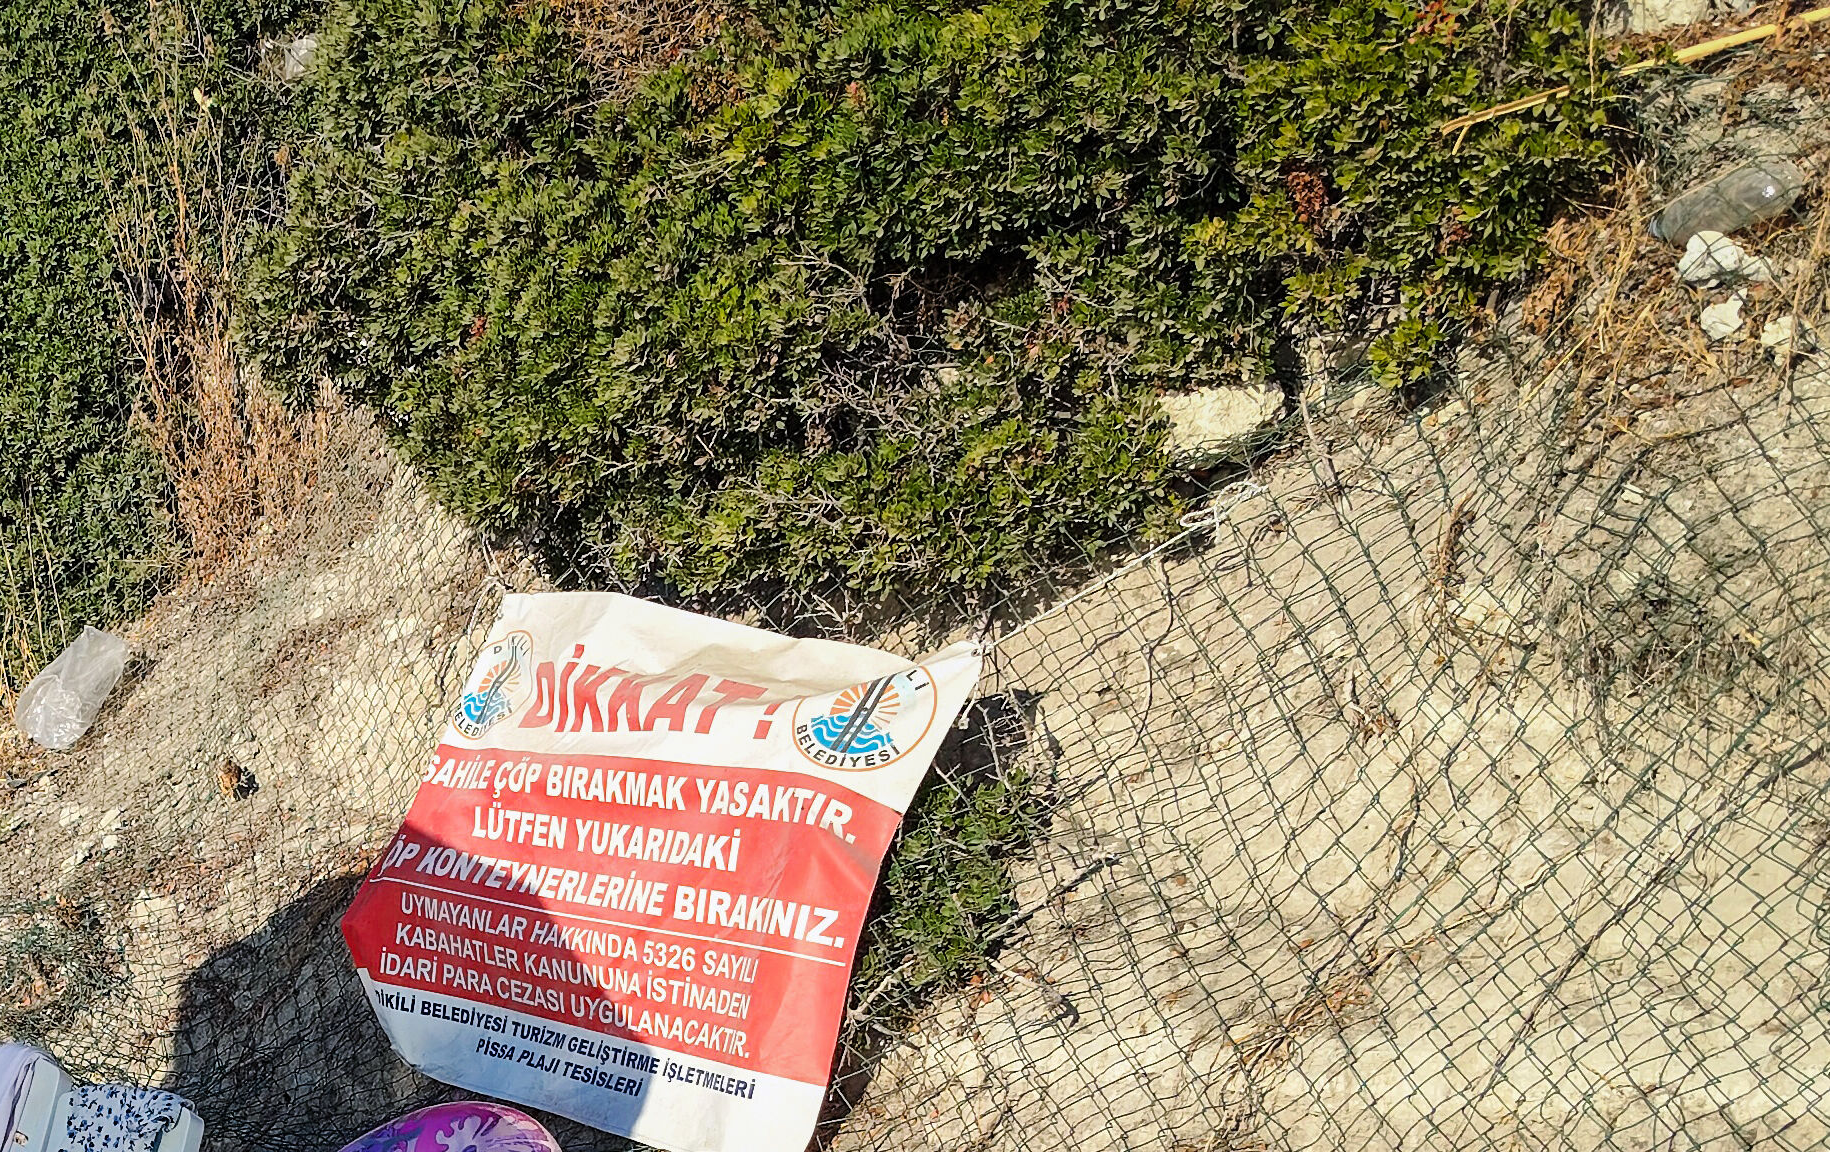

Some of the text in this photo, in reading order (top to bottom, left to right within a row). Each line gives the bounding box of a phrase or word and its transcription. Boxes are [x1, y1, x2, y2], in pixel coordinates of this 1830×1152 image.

[795, 723, 901, 769] BELEDİYESİ
[422, 753, 857, 845] SAHİLE ÇÖP BIRAKMAK YASAKTIR.
[471, 801, 742, 873] LÜTFEN YUKARIDAKİ
[377, 834, 846, 949] ÖP KONTEYNERLERİNE BIRAKINIZ.
[401, 891, 759, 984] UYMAYANLAR HAKKINDA 5326 SAYILI
[379, 946, 750, 1059] İDARİ PARA CEZASI UYGULANACAKTIR.
[395, 922, 752, 1020] KABAHATLER KANUNUNA İSTİNADEN
[420, 1000, 508, 1034] BELEDİYESİ
[511, 1020, 567, 1050] TURİZM
[567, 1036, 661, 1075] GELİŞTİRME
[662, 1058, 756, 1100] İŞLETMELERİ
[476, 1036, 644, 1097] PİSSA PLAJI TESİSLERİ
